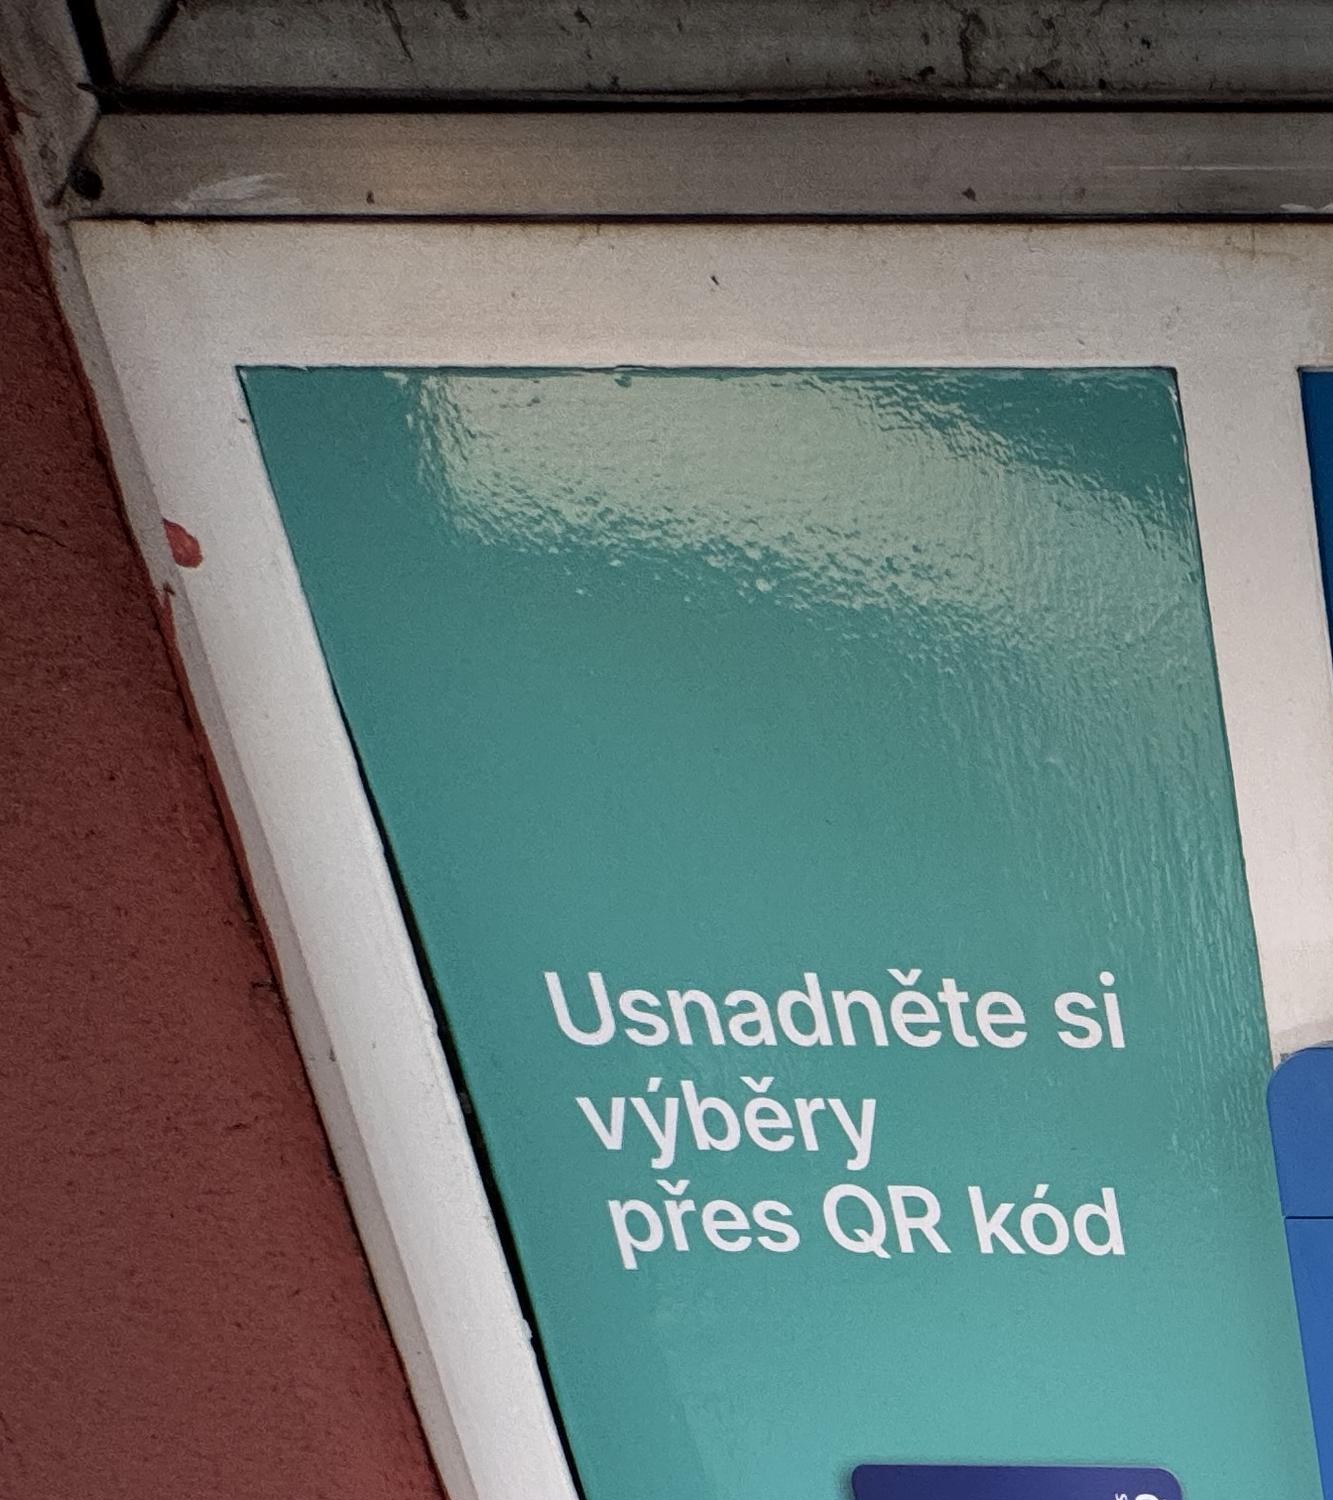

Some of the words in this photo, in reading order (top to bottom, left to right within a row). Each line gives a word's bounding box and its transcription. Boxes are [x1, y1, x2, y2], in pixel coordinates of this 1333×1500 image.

[543, 967, 1028, 1050] Usnadněte
[1052, 970, 1126, 1050] si
[575, 1075, 877, 1171] výběry
[607, 1178, 801, 1271] přes
[822, 1182, 952, 1260] QR
[967, 1182, 1126, 1257] kód
